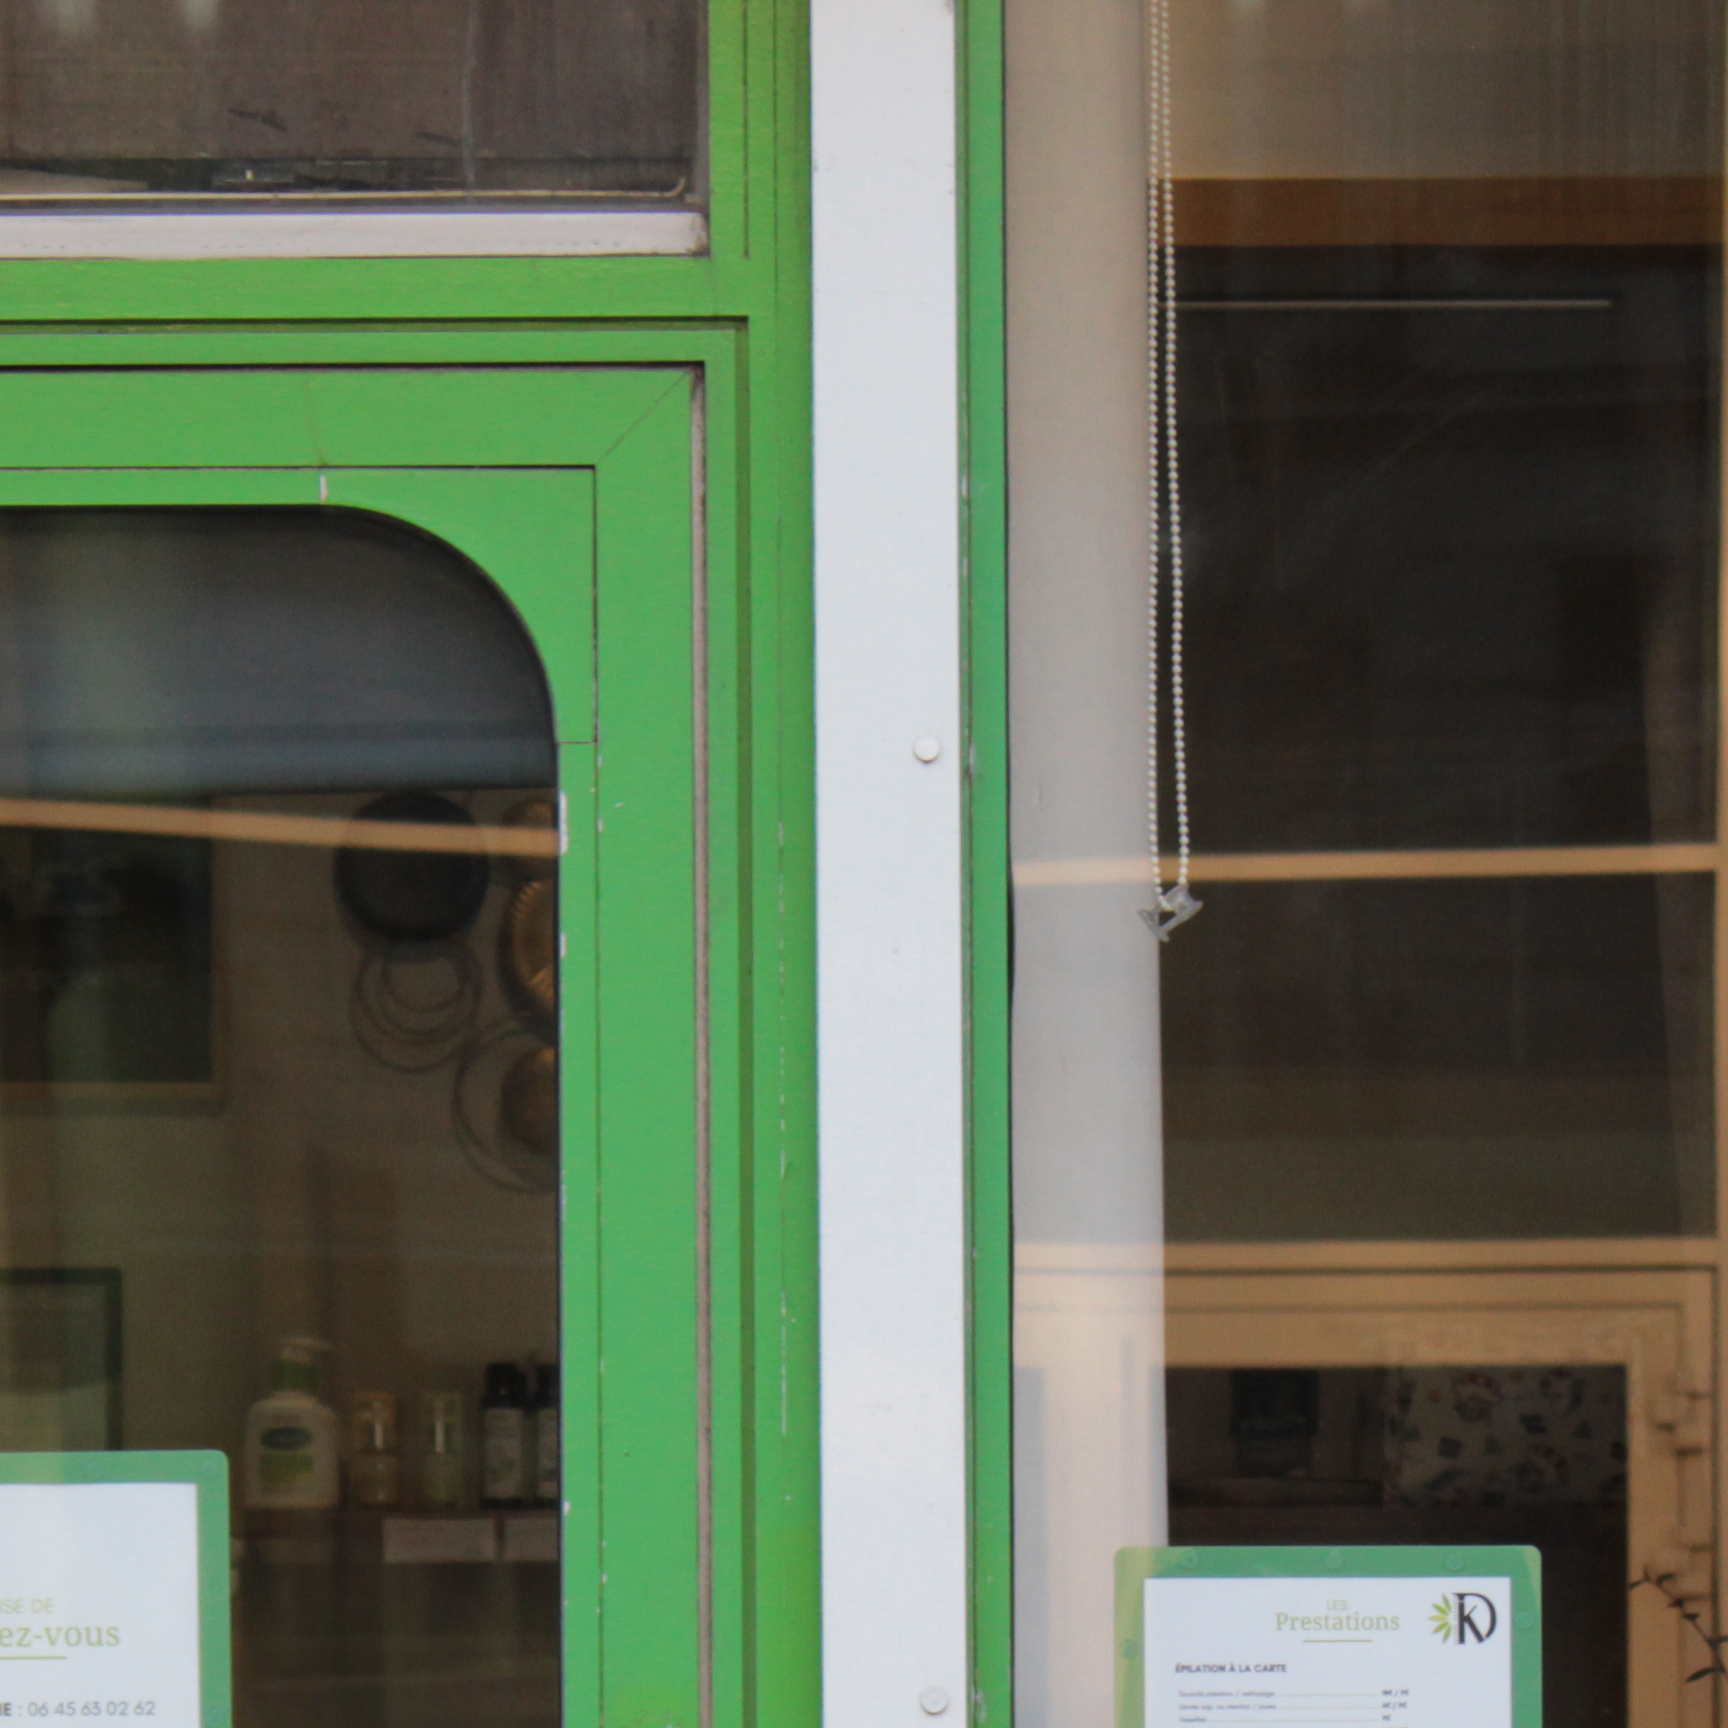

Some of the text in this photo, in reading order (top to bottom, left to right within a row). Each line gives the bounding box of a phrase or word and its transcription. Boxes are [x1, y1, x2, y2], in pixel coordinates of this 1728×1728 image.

[31, 1599, 54, 1613] DE
[1326, 1600, 1348, 1611] LES
[1275, 1611, 1401, 1631] Prestations
[1175, 1662, 1287, 1673] ÉPILATION À LA CARTE
[27, 1702, 49, 1717] 06
[54, 1702, 76, 1716] 45
[107, 1701, 129, 1716] 02
[133, 1701, 156, 1716] 62
